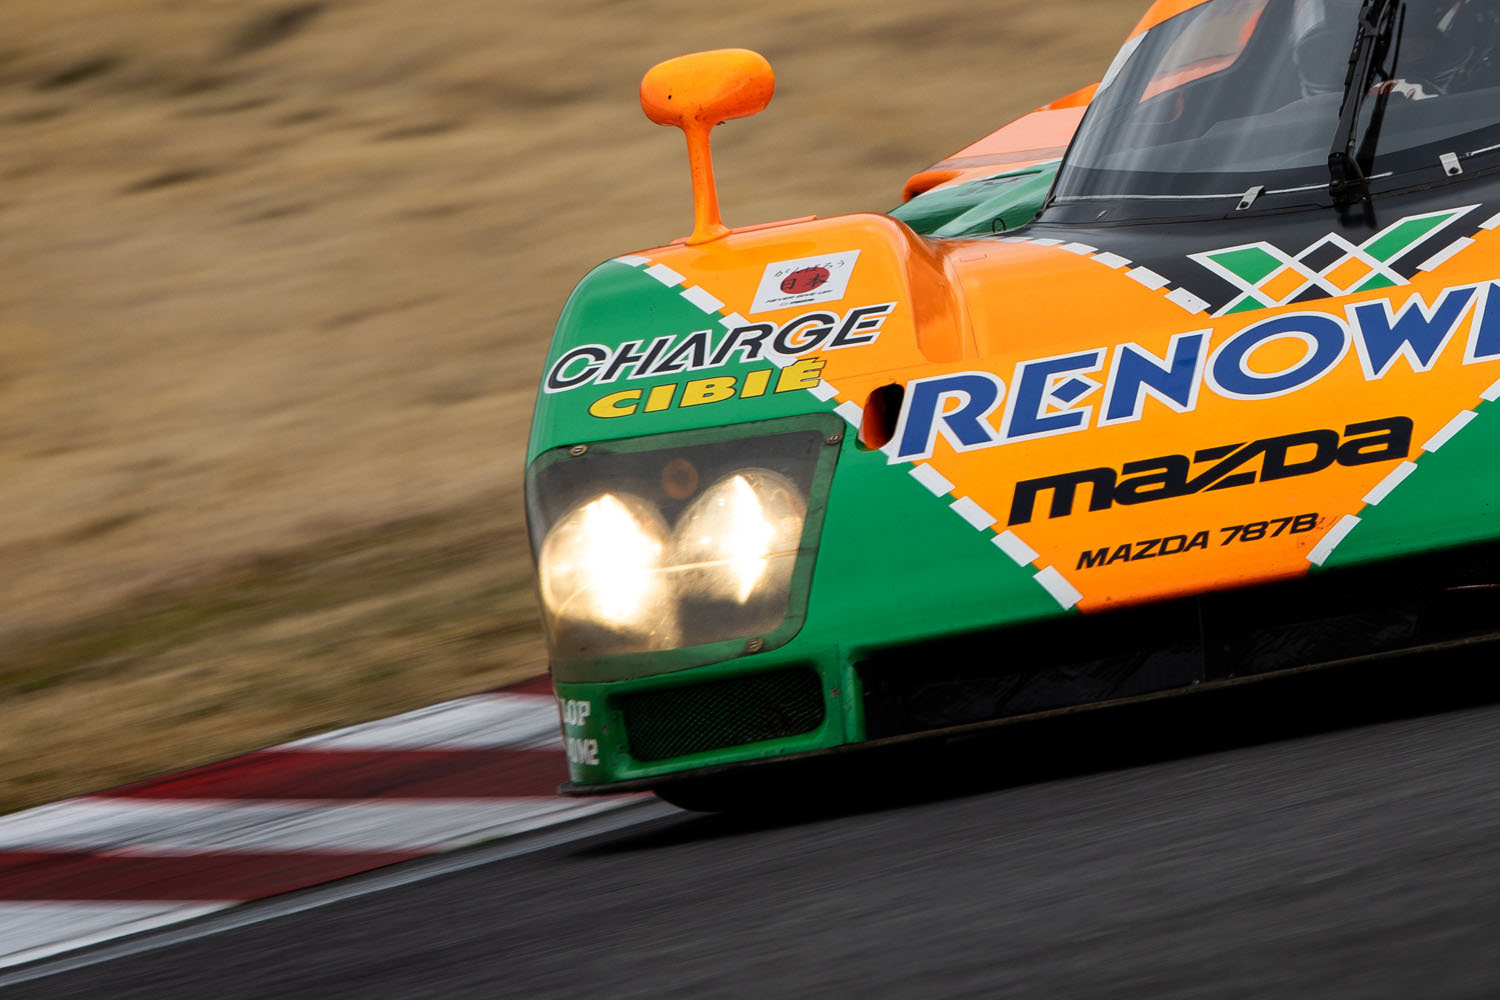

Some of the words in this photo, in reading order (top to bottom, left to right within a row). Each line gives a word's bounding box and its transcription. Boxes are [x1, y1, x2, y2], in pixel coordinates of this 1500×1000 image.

[544, 302, 898, 394] CHARGE
[1076, 530, 1209, 570] MAZDA
[1219, 512, 1320, 547] 787B
